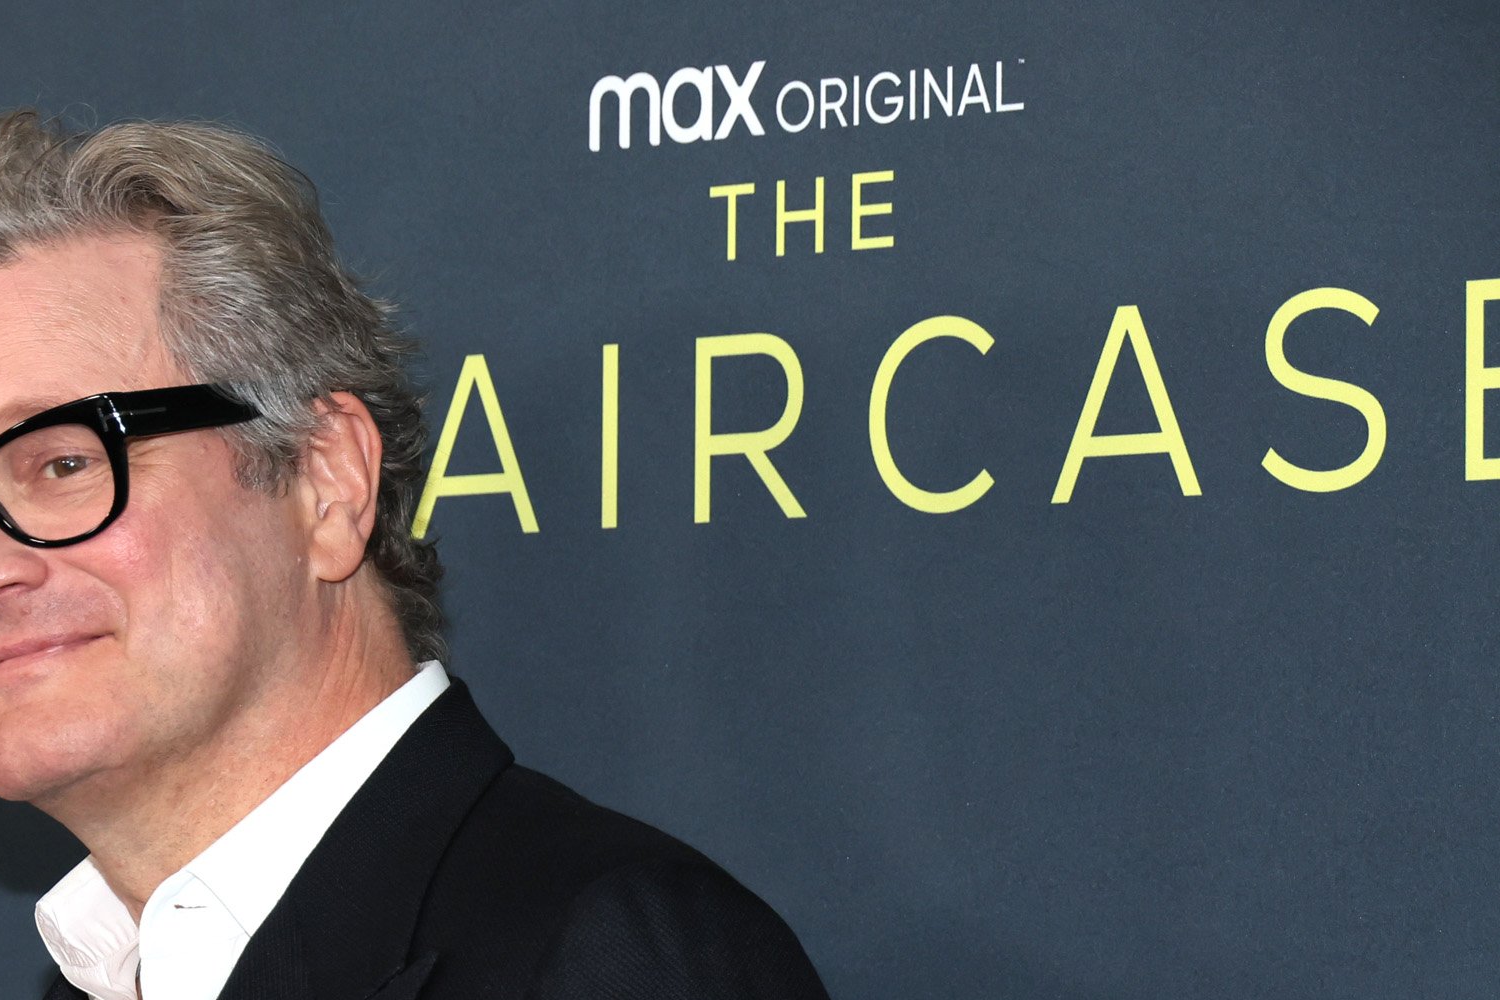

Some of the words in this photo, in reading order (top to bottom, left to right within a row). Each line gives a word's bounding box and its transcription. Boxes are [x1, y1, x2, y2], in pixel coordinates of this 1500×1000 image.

[588, 60, 767, 153] max
[775, 60, 1025, 133] ORIGINAL
[709, 170, 895, 261] THE
